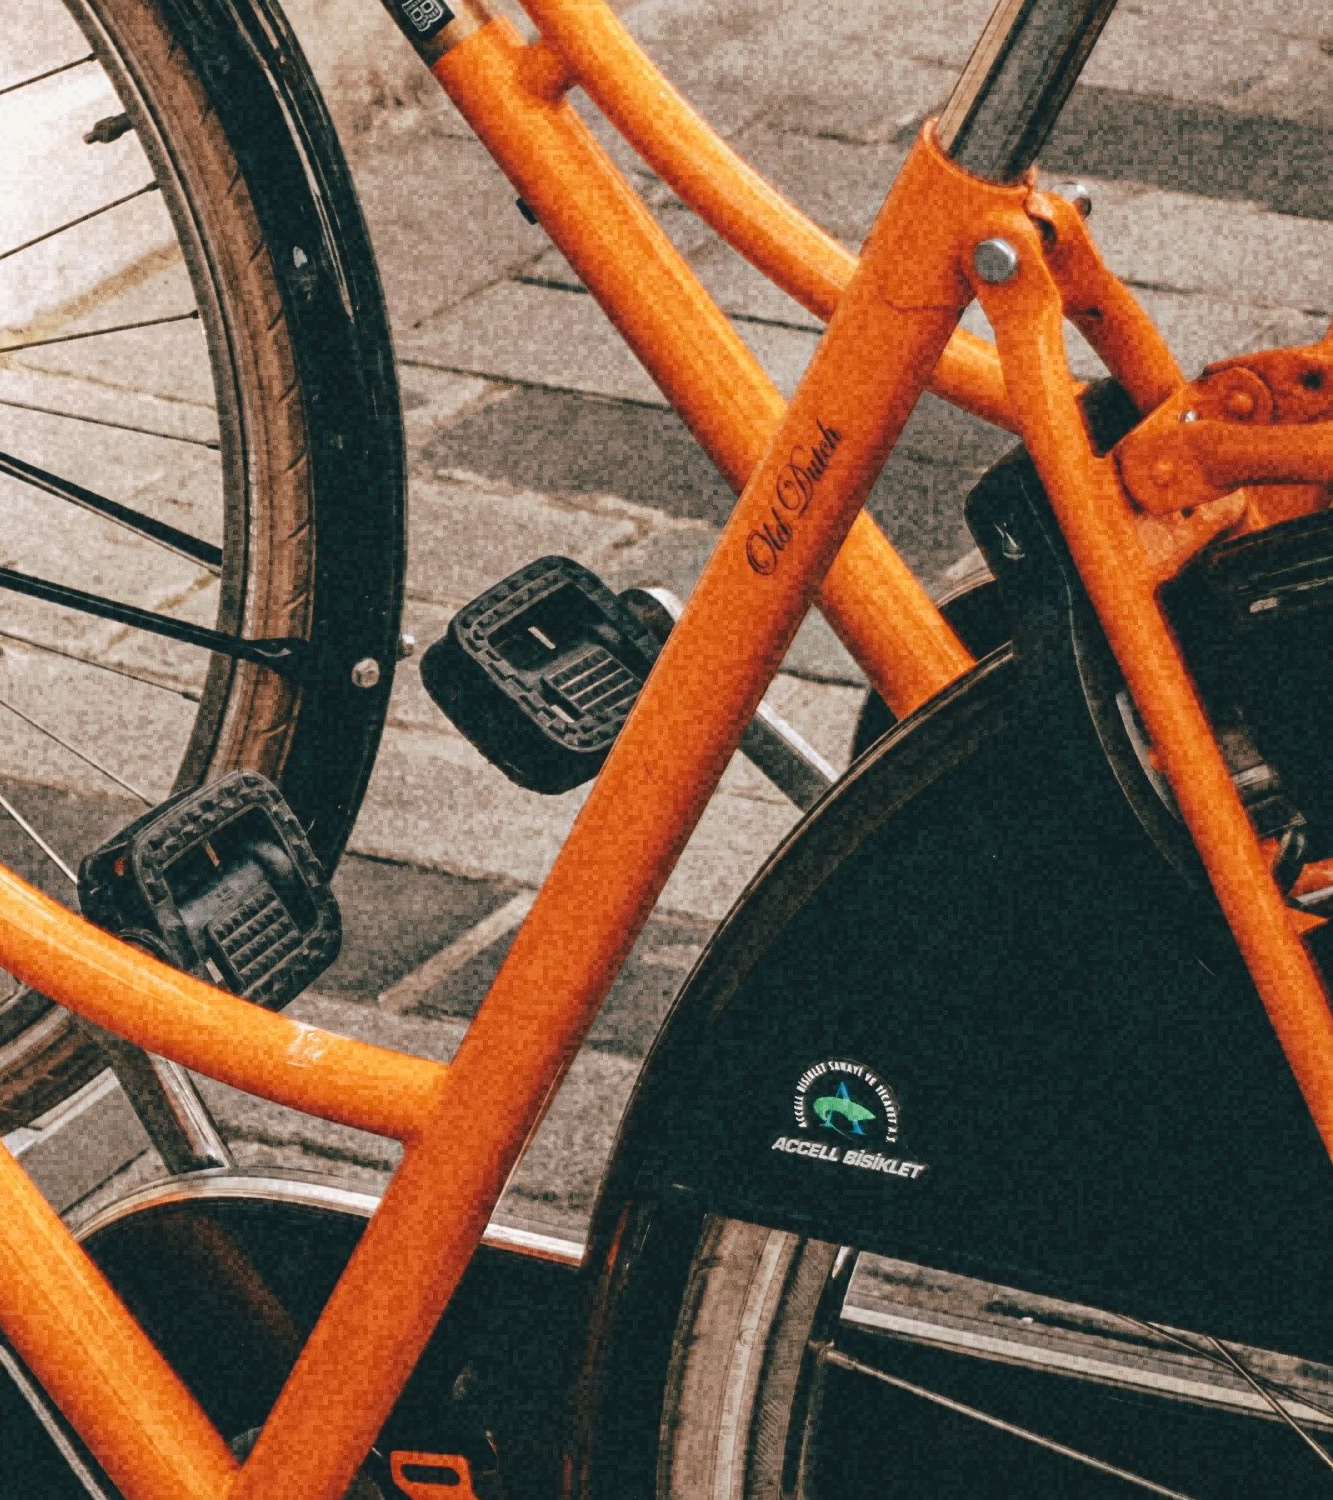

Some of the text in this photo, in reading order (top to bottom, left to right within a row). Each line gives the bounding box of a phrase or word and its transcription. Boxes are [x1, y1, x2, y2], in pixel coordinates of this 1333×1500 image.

[745, 417, 843, 577] Old Dutch
[794, 1095, 808, 1128] ACCELL
[864, 1072, 877, 1087] VE
[771, 1136, 927, 1180] ACCELL BİSİKLET
